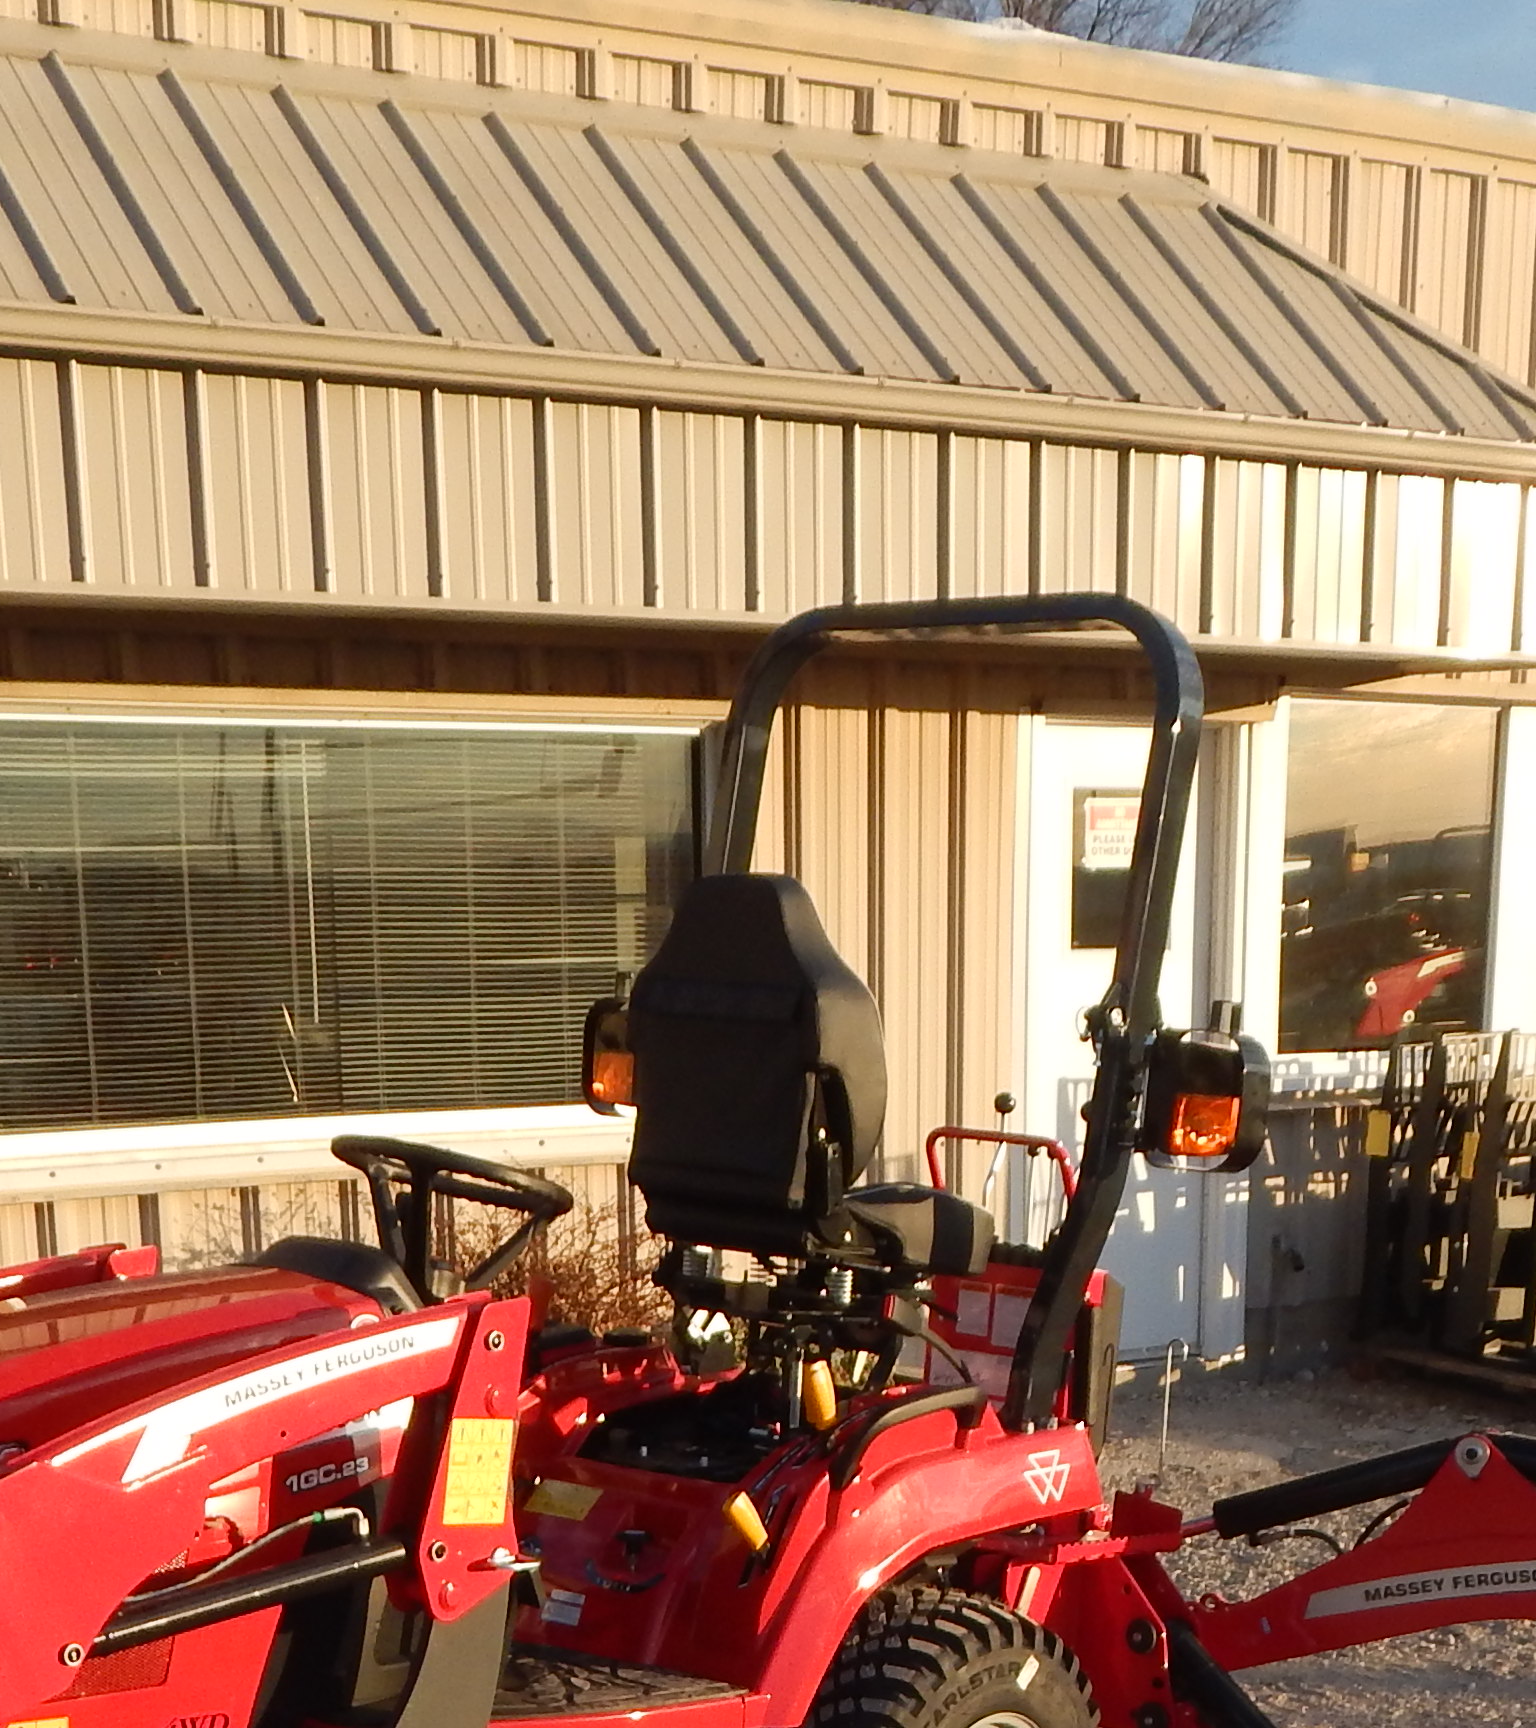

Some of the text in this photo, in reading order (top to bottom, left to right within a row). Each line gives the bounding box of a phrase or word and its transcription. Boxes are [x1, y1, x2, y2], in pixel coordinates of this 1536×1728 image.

[1091, 846, 1120, 856] OTHER
[1092, 834, 1125, 844] PLEASE
[224, 1335, 415, 1408] MASSEY FERGUSON
[285, 1456, 370, 1492] 1GC.23
[1364, 1577, 1445, 1602] MASSEY
